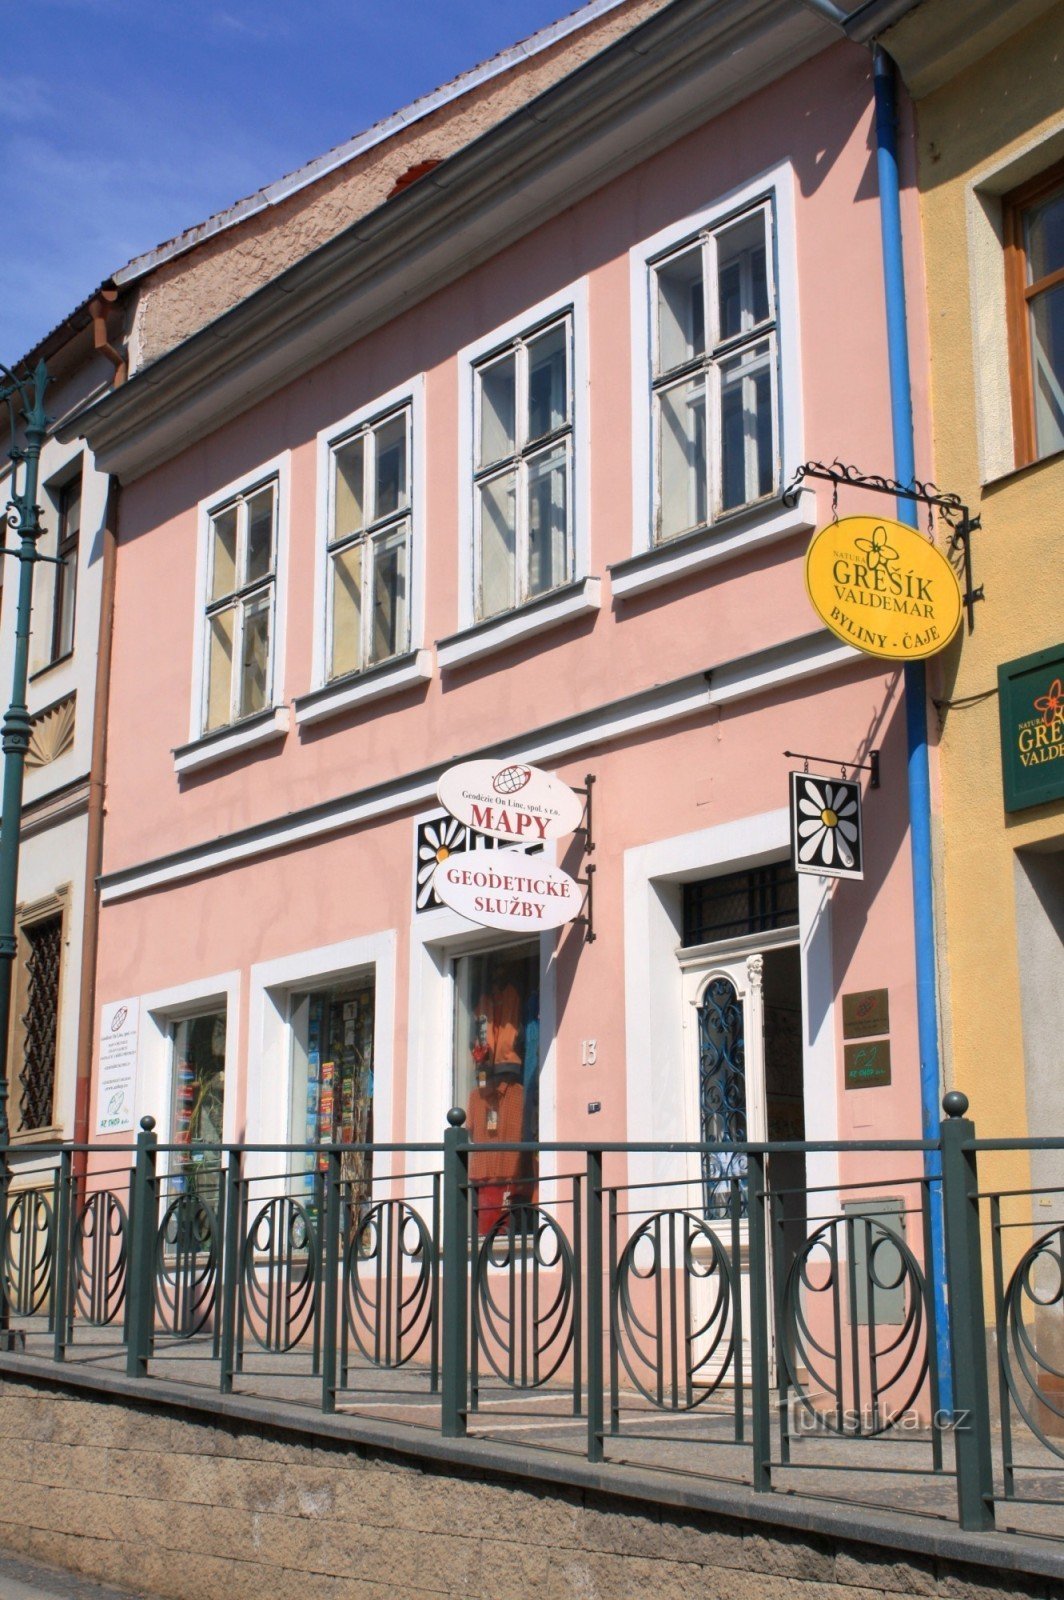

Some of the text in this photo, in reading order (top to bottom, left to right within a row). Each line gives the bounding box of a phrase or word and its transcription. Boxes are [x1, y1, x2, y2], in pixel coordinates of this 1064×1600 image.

[833, 551, 866, 563] NATURA
[833, 560, 933, 602] GREŠÍK
[834, 585, 935, 619] VALDEMAR
[830, 606, 888, 648] BYLINY
[902, 625, 941, 649] ČAJE
[1018, 717, 1044, 730] NATURA
[462, 791, 493, 804] Geodézie
[495, 797, 507, 806] On
[471, 804, 552, 839] MAPY
[447, 869, 570, 898] GEODETICKÉ
[475, 896, 546, 918] SLUŽBY
[582, 1040, 597, 1066] 13
